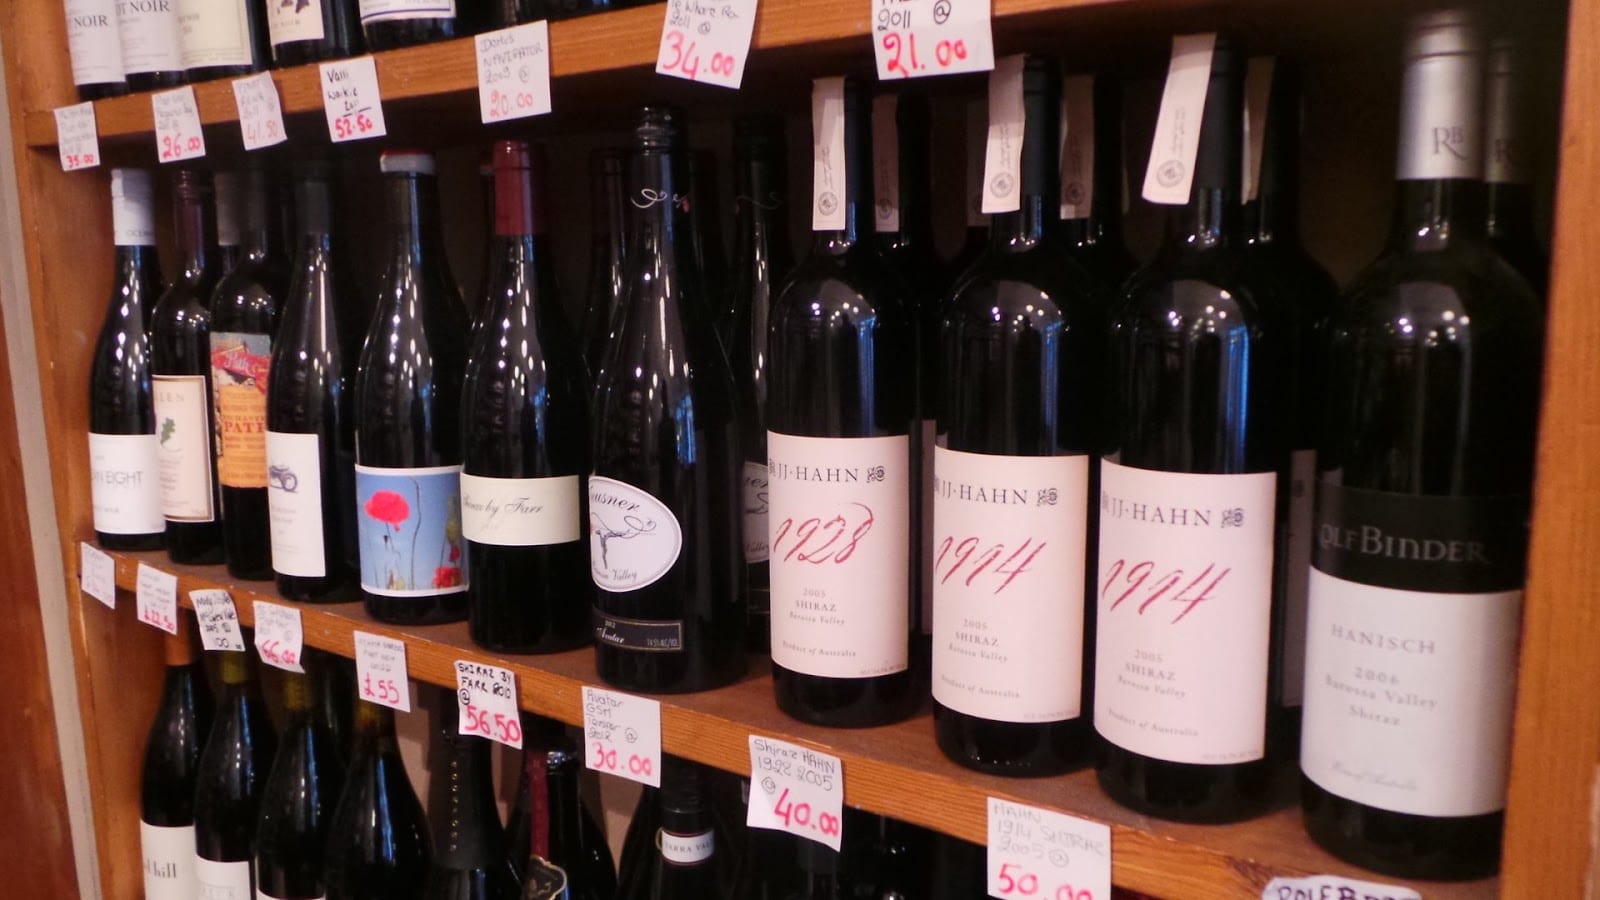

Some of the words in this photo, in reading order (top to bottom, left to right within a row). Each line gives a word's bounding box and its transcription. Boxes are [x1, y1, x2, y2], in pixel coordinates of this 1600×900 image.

[74, 15, 108, 27] NOIR
[878, 9, 911, 31] 2011
[933, 0, 951, 24] @
[698, 22, 710, 35] @
[663, 31, 735, 80] 34.00
[883, 33, 967, 79] 21.00
[489, 90, 534, 117] 20.00
[335, 114, 373, 139] 52.50
[162, 133, 201, 158] 26.00
[503, 496, 544, 514] Farr
[773, 502, 874, 565] 1928
[795, 600, 837, 612] SHIRAZ
[955, 631, 999, 647] SHIRAZ
[1330, 623, 1436, 655] HANISCH
[458, 663, 495, 679] SHIRAZ
[1125, 661, 1176, 682] SHIRAZ
[461, 676, 488, 693] FARR
[586, 689, 624, 708] Avatar
[1384, 690, 1438, 711] Valley
[586, 703, 611, 718] GSM
[1349, 704, 1400, 727] Shiraz
[465, 704, 520, 742] 56.50
[625, 727, 638, 744] @
[592, 741, 651, 776] 30.00
[754, 738, 798, 760] Shiraz
[803, 751, 835, 775] HAHN
[760, 776, 776, 795] @
[774, 787, 838, 836] 40.00
[1048, 849, 1069, 868] @
